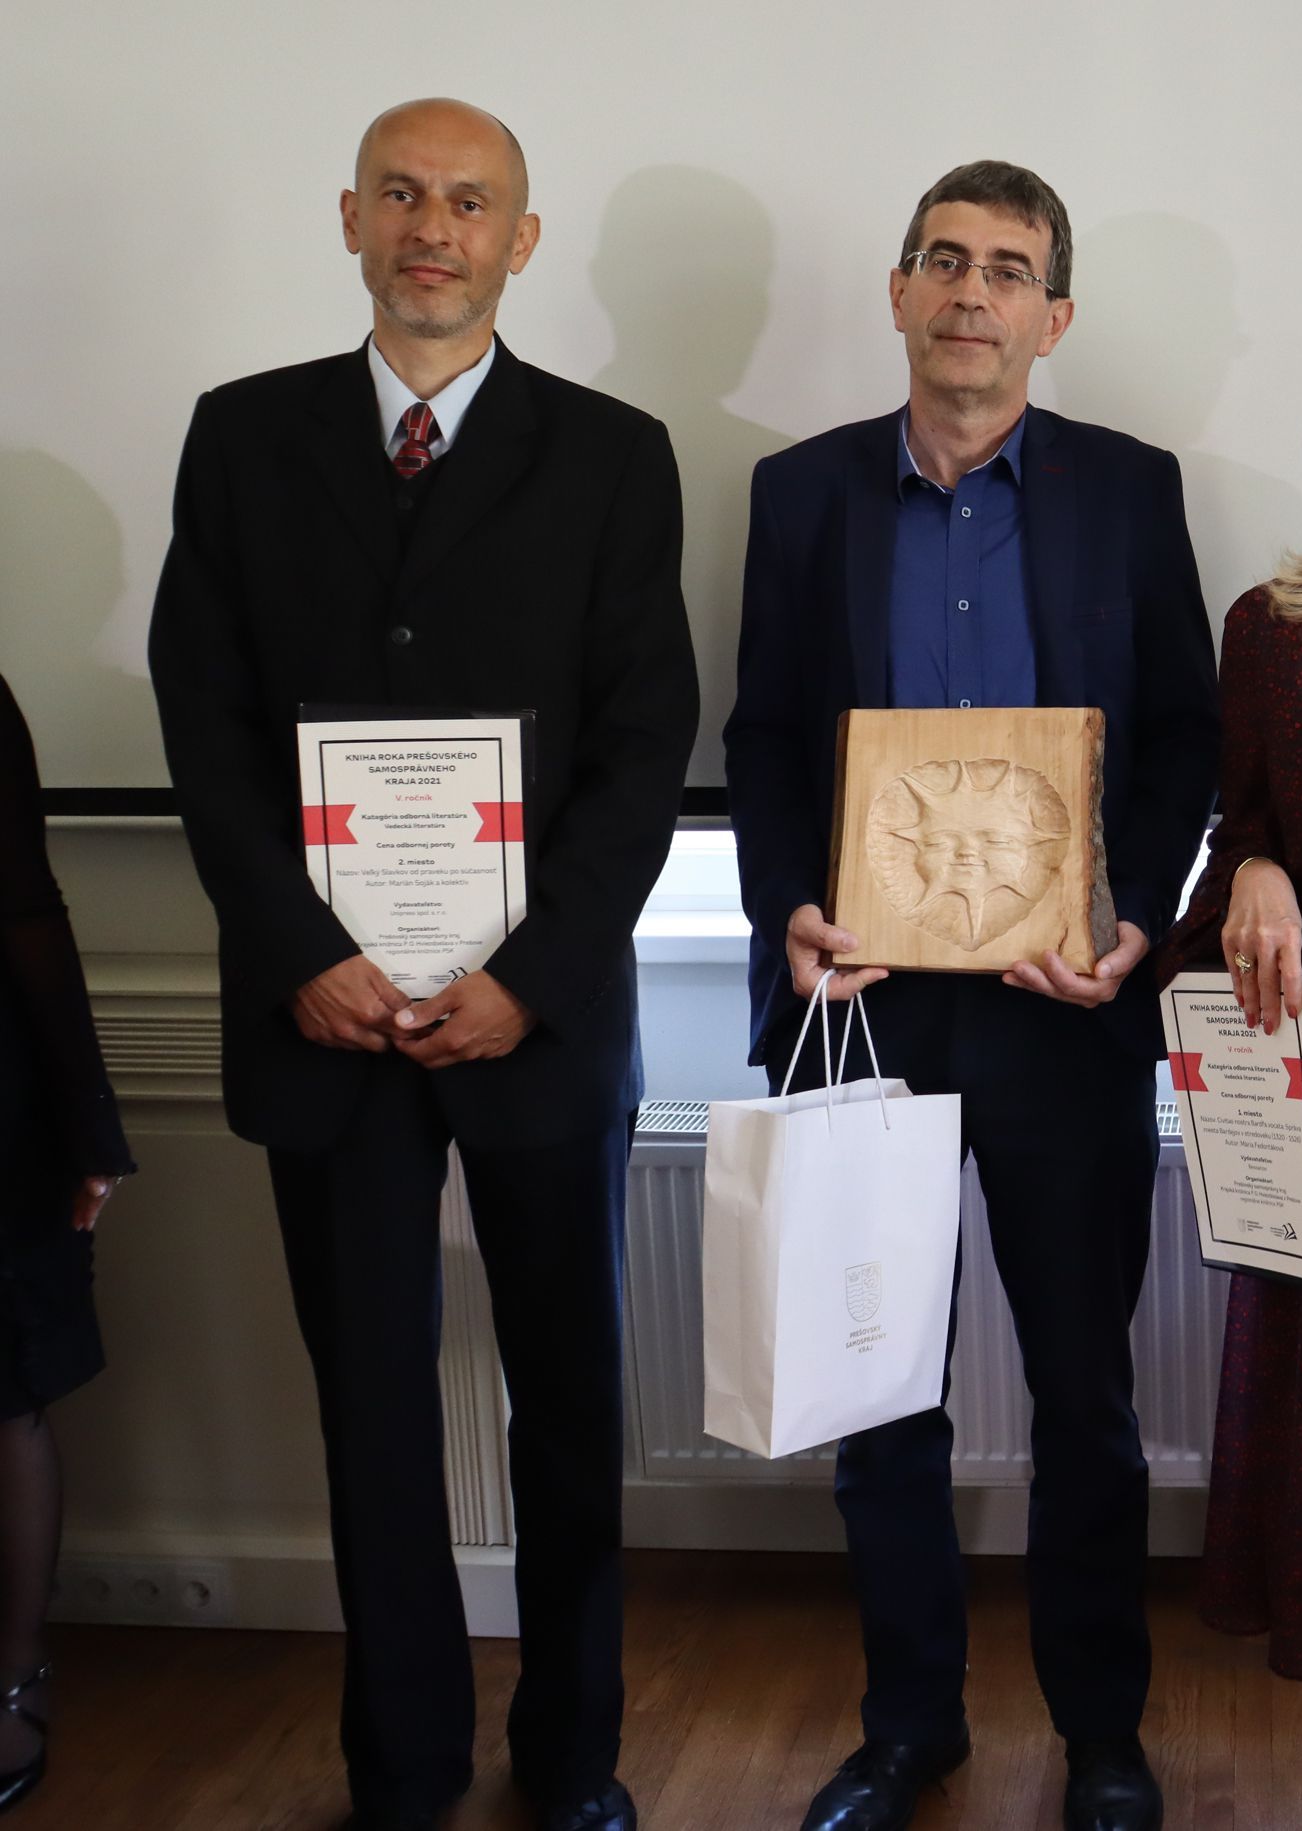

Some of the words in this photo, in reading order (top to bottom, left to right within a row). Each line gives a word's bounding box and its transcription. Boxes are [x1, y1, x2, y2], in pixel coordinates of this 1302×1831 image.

[345, 753, 376, 762] KNIHA
[378, 753, 404, 761] ROKA
[406, 751, 477, 760] PREŠOVSKÉHO
[368, 764, 456, 774] SAMOSPRÁVNEHO
[385, 777, 416, 785] KRAJA
[418, 777, 441, 785] 2021
[405, 794, 432, 802] ročník
[361, 813, 398, 821] Kategória
[396, 842, 428, 850] odbornej
[430, 842, 455, 850] poroty
[1189, 1004, 1210, 1012] KNIHA
[1218, 1029, 1240, 1037] KRAJA
[1234, 1046, 1253, 1054] ročník
[1221, 1091, 1234, 1099] Cena
[1234, 1092, 1256, 1101] odbornej
